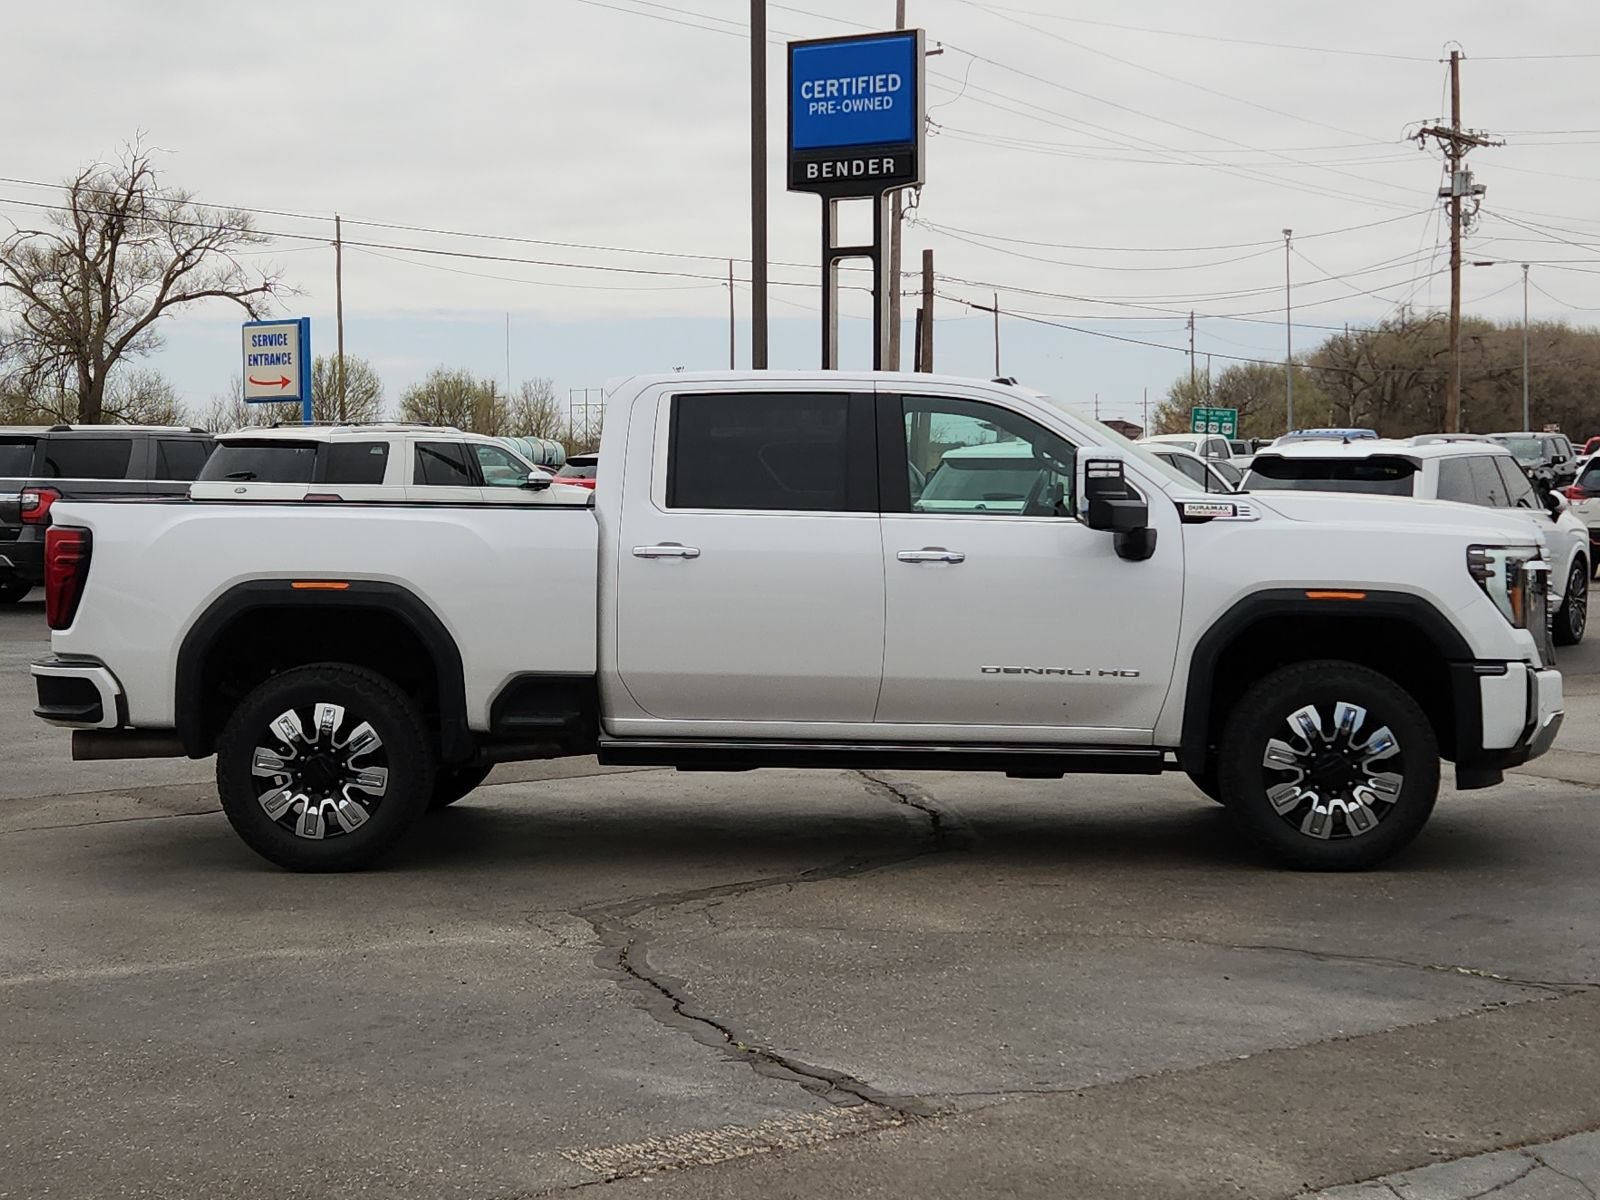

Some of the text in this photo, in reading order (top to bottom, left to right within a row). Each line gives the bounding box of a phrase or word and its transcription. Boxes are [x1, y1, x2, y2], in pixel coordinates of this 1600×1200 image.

[801, 73, 901, 99] CERTIFIED
[809, 96, 893, 116] PRE-OWNED
[806, 158, 895, 179] BENDER
[251, 333, 288, 348] SERVICE
[248, 352, 292, 367] ENTRANCE
[1209, 423, 1218, 431] 70
[981, 665, 1140, 678] DENALI HD
